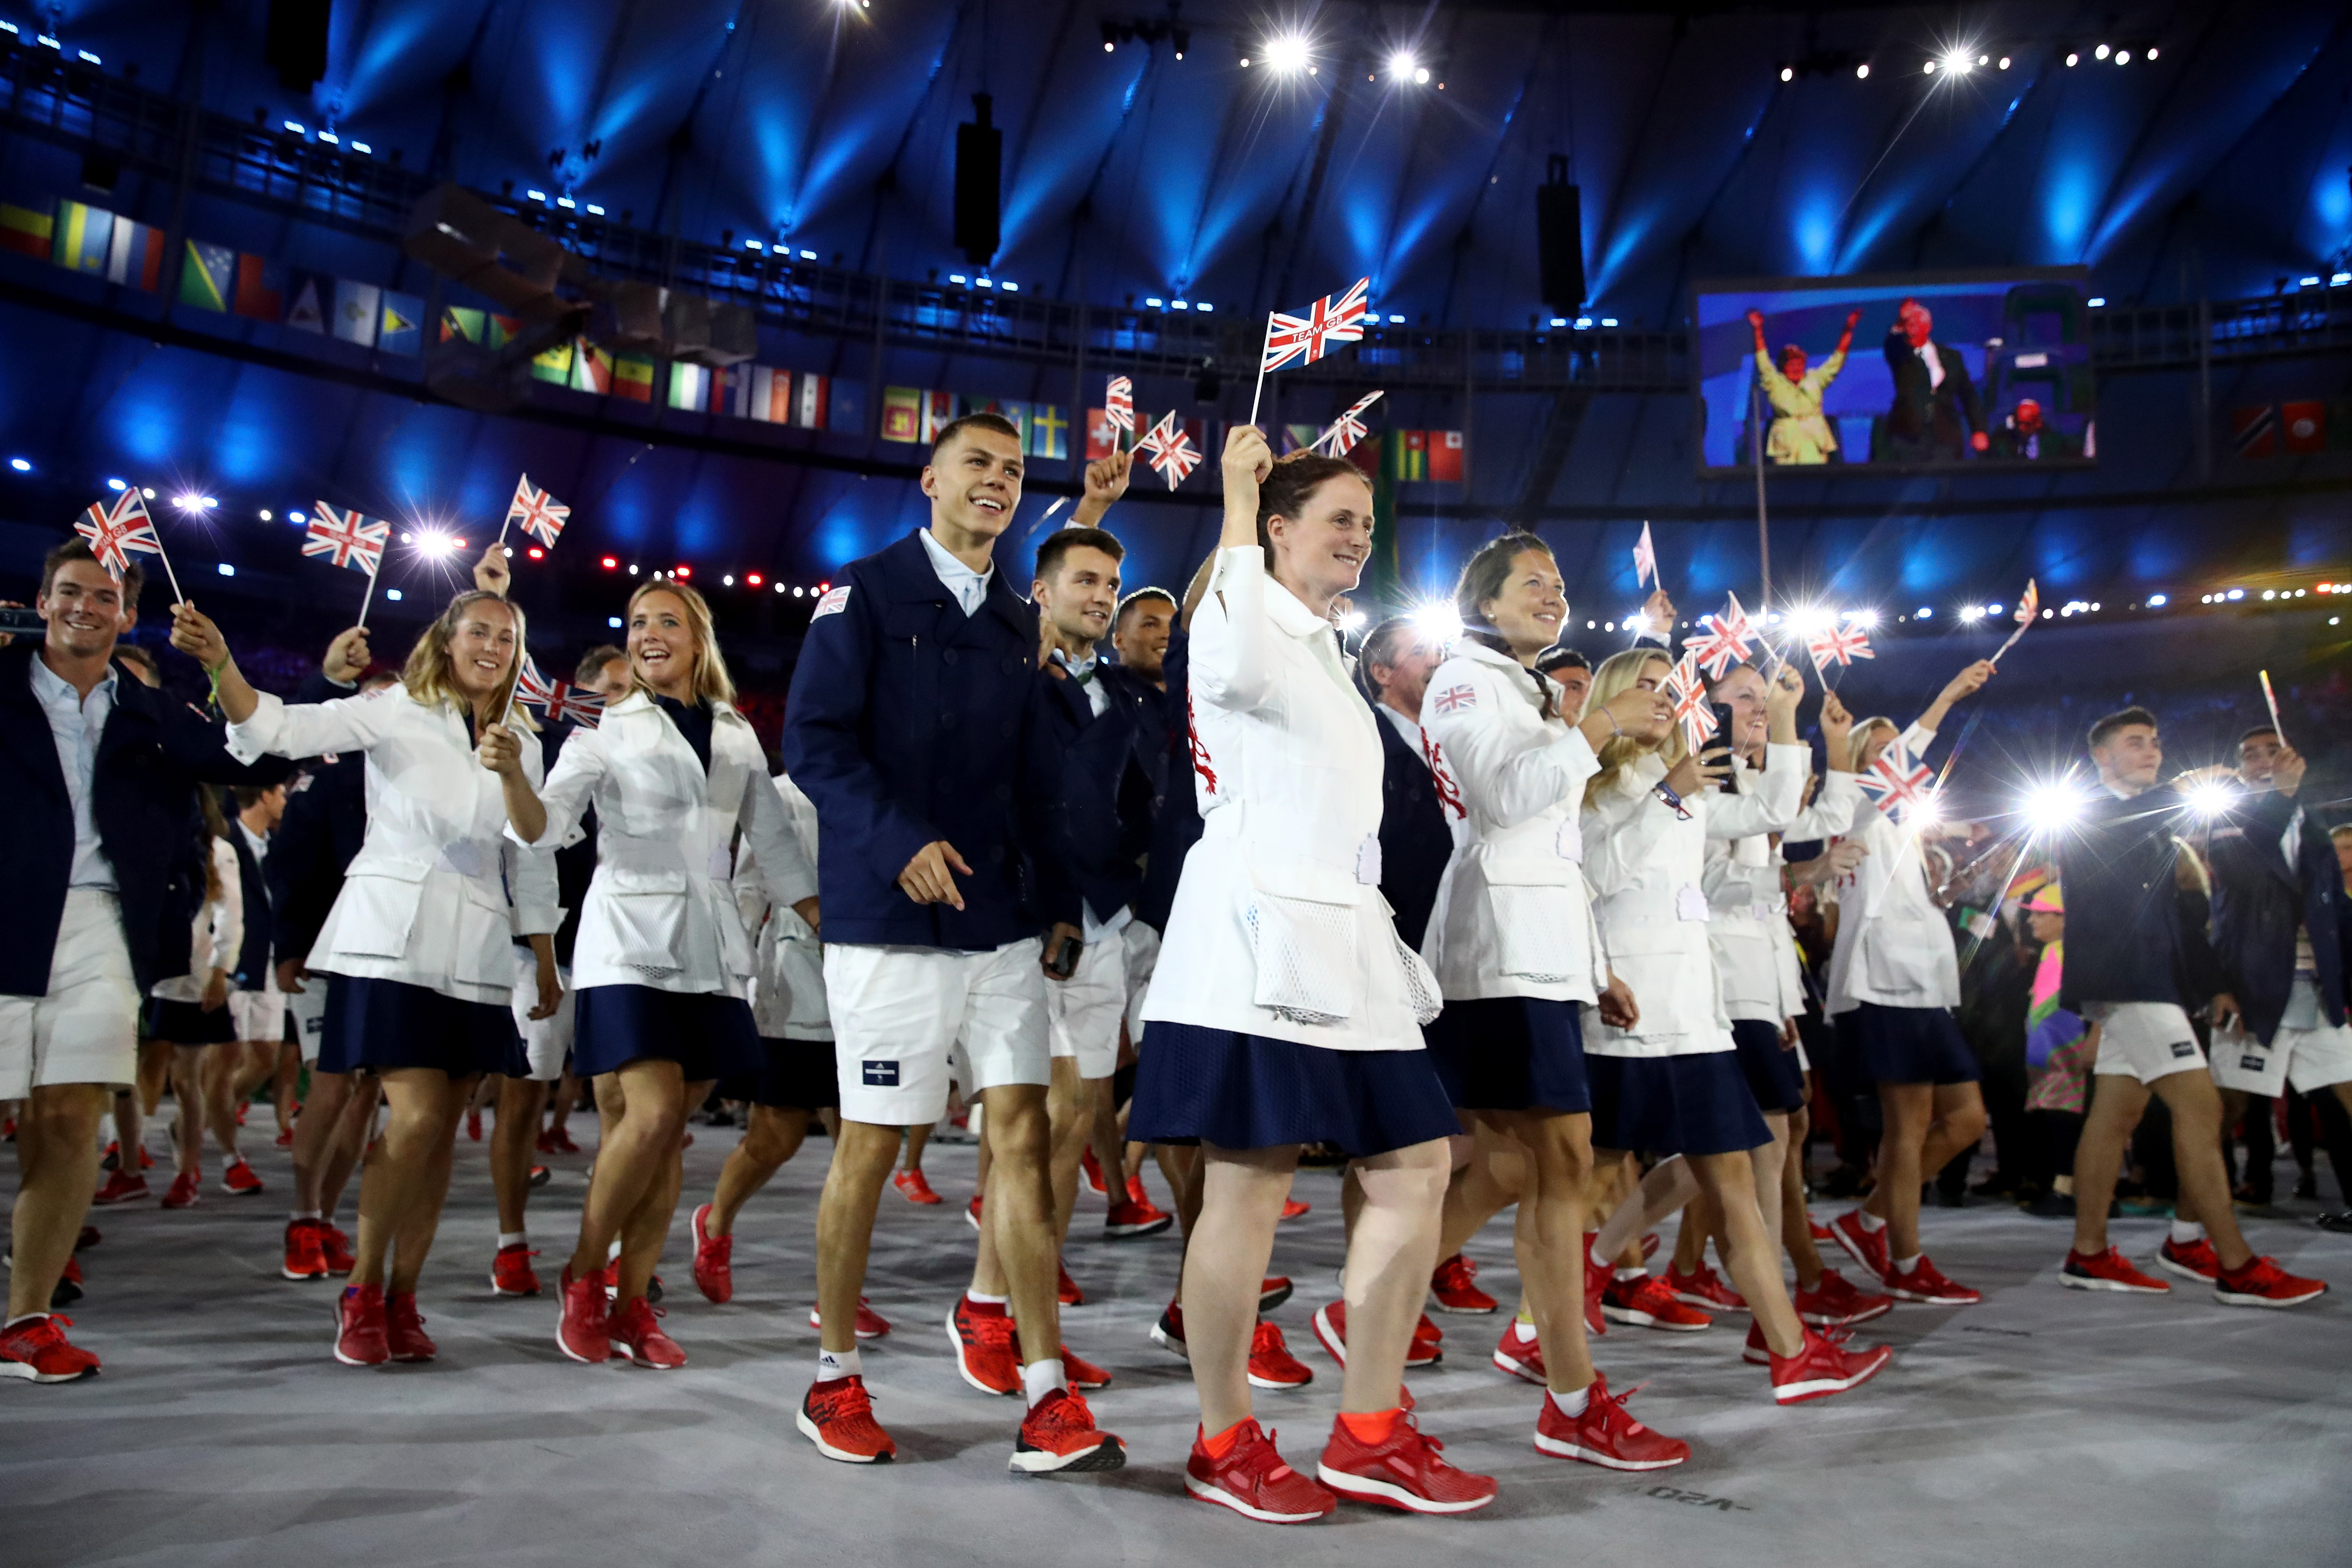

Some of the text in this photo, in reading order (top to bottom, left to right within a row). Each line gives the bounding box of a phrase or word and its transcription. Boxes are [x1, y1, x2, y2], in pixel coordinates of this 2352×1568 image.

[1293, 315, 1343, 342] TEAM GB
[113, 524, 127, 538] GB
